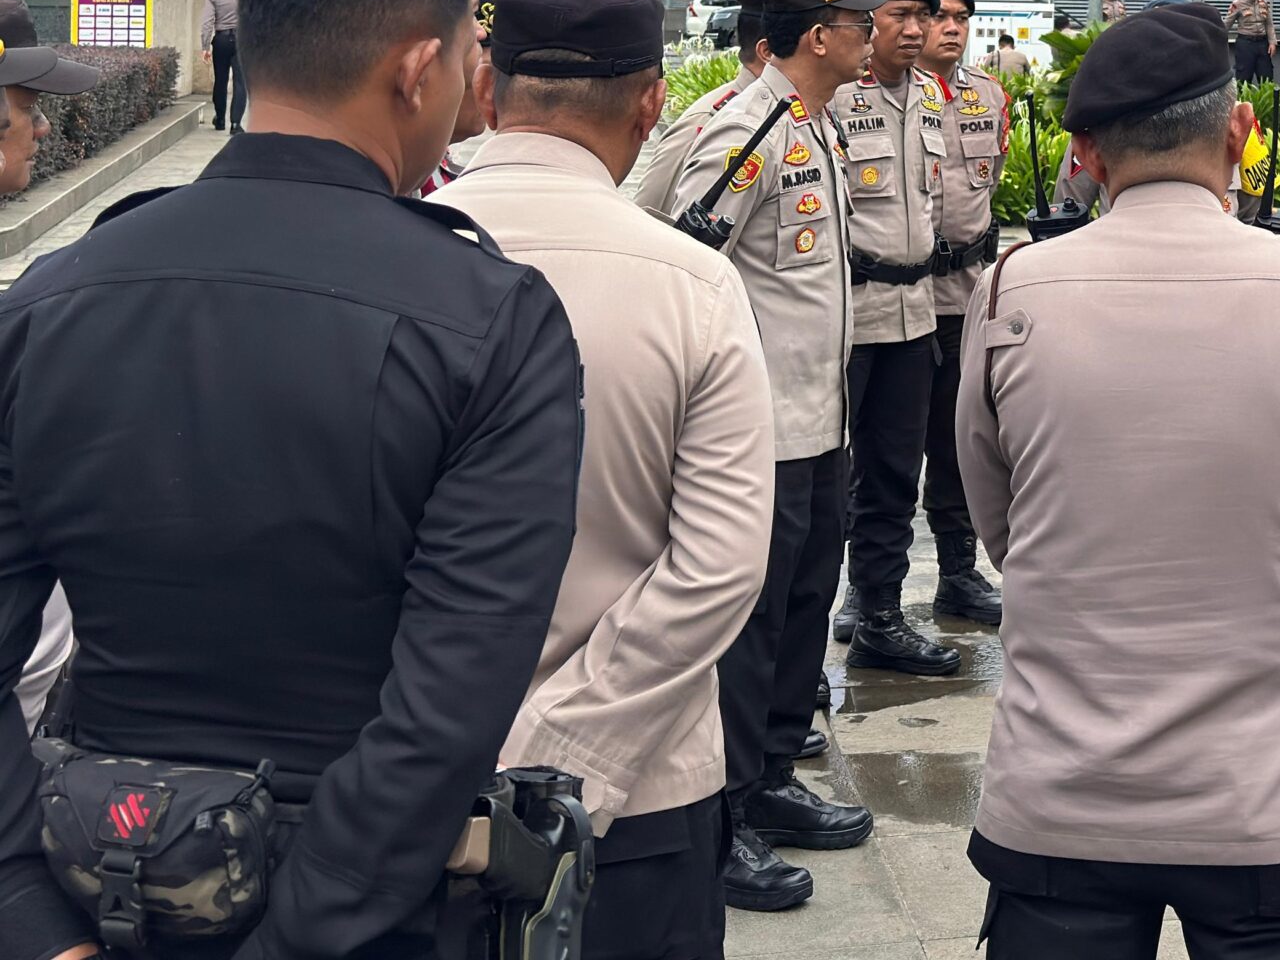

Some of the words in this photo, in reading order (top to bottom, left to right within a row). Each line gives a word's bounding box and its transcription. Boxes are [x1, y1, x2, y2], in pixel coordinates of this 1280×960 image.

[848, 116, 885, 132] HALIM
[960, 120, 993, 133] POLRI
[781, 168, 821, 190] M.RASID
